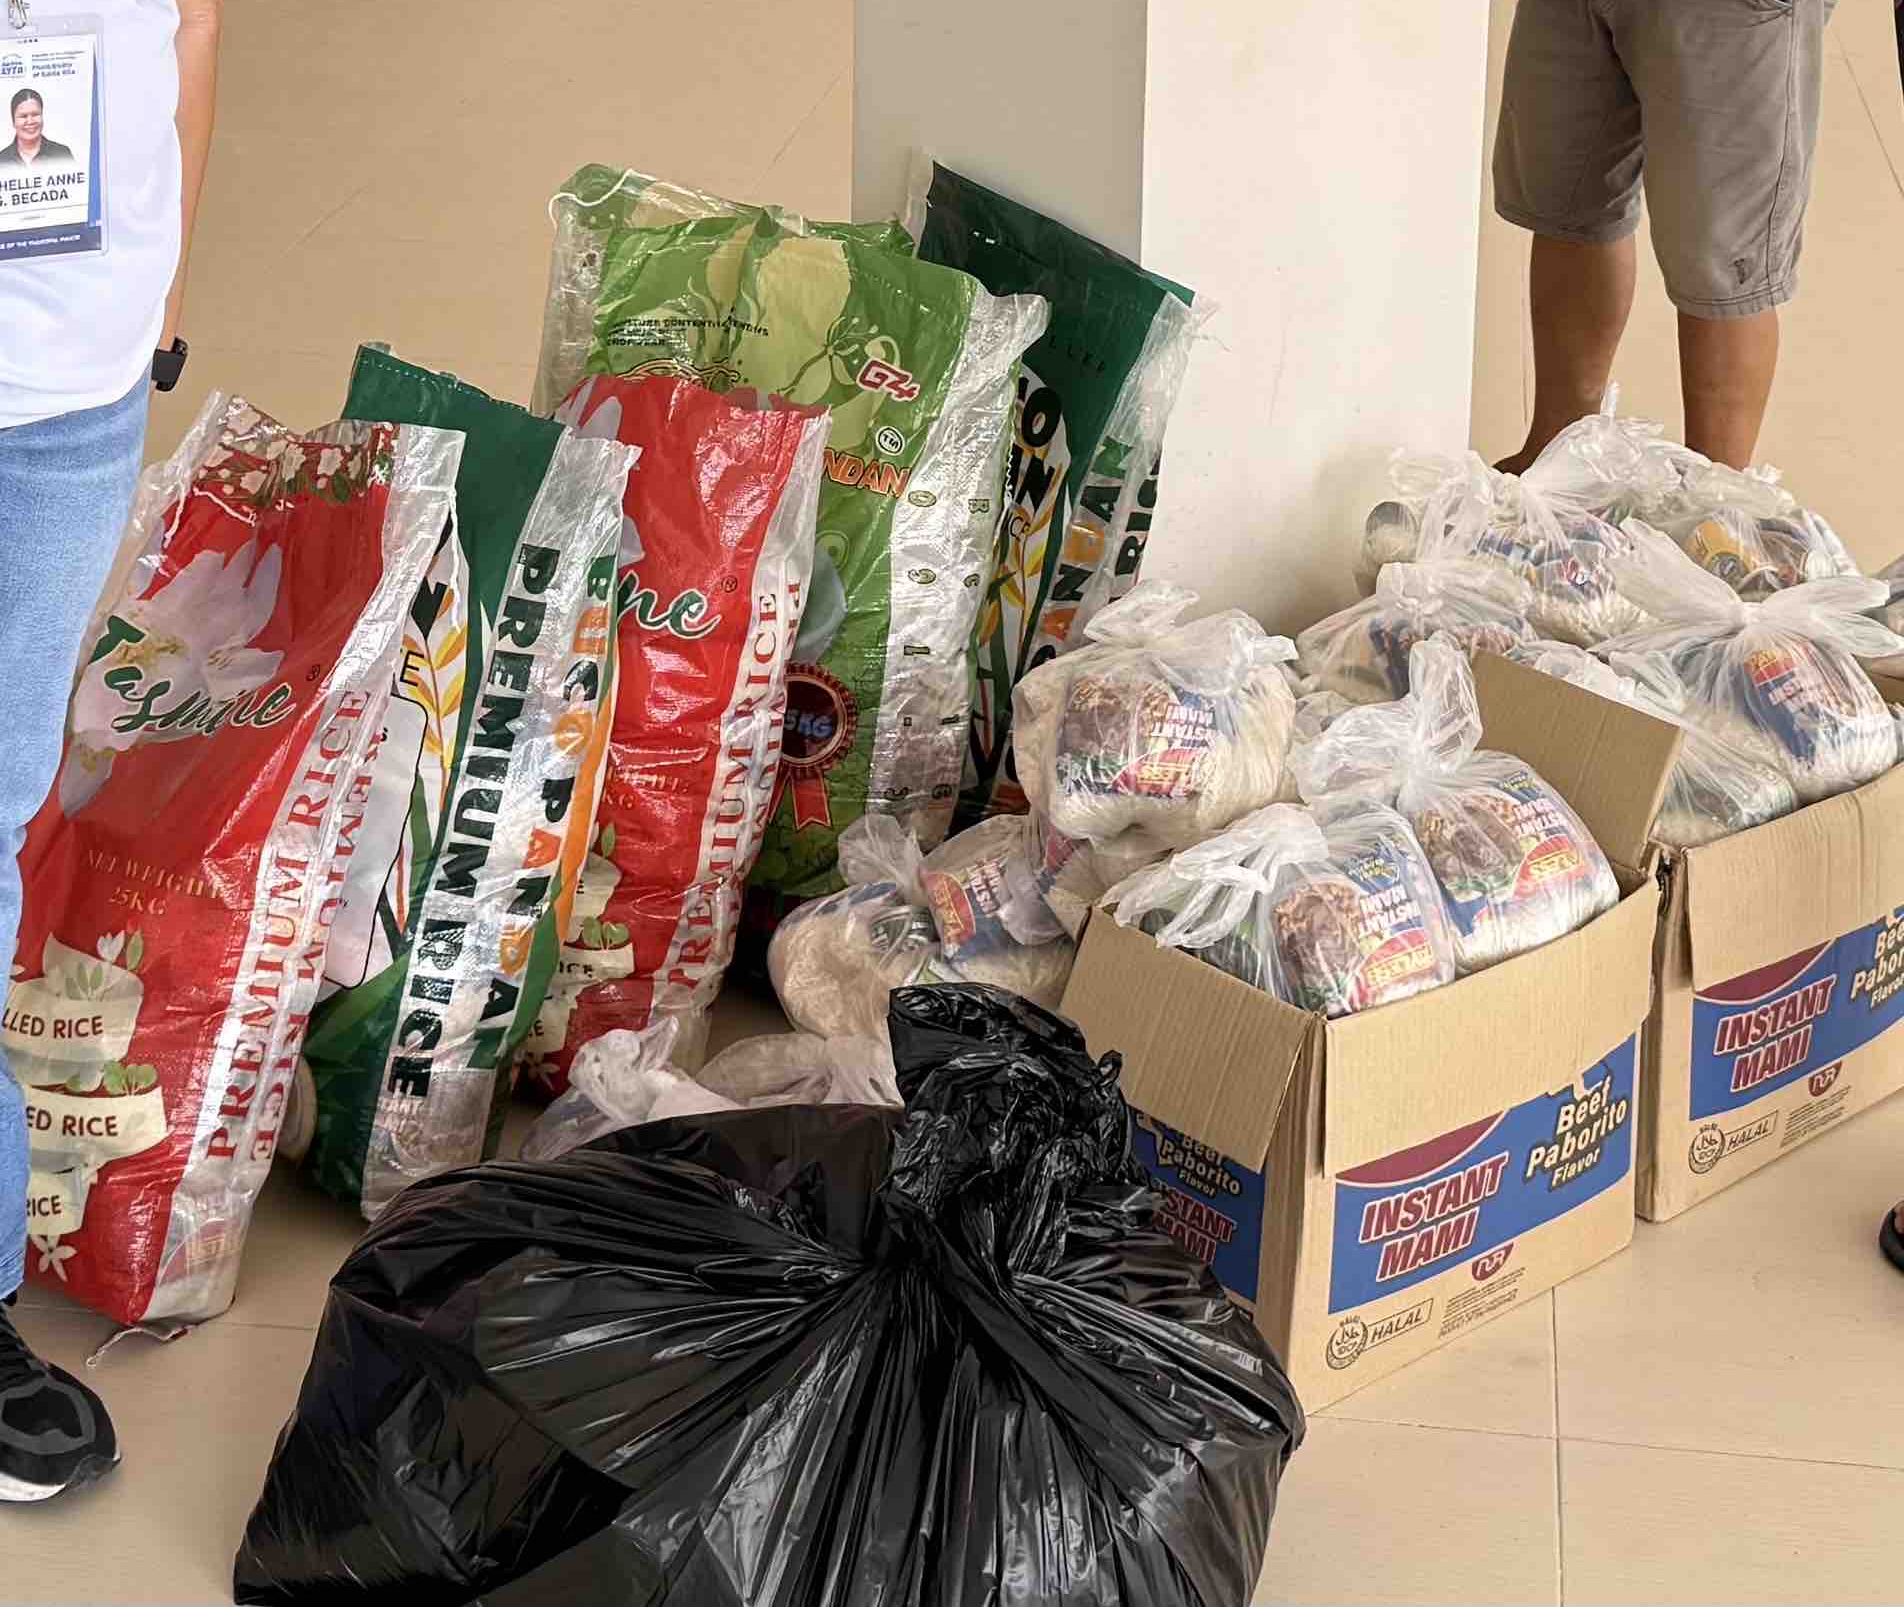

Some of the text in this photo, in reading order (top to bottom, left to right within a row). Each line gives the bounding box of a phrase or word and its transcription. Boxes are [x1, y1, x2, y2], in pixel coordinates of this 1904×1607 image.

[11, 188, 69, 206] BECADA
[46, 171, 86, 187] ANNE
[823, 447, 913, 500] NDAN
[552, 554, 618, 756] BUCO
[435, 542, 562, 899] PREMIUM
[667, 746, 754, 989] PREMIUM
[734, 593, 778, 718] RICE
[207, 857, 310, 1160] PREMIUM
[286, 692, 371, 827] RICE
[467, 776, 576, 1070] PANDAN
[52, 1014, 104, 1039] RICE
[388, 918, 464, 1098] RICE
[1713, 974, 1837, 1057] INSTANT
[1730, 1024, 1813, 1094] MAMI
[61, 1114, 118, 1138] RICE
[1525, 1098, 1629, 1179] Paborito
[1554, 1076, 1614, 1135] Beef
[1727, 1119, 1769, 1152] HALAL
[1161, 1138, 1242, 1196] Paborito
[1358, 1152, 1510, 1244] INSTANT
[1549, 1145, 1602, 1193] Flavor
[1376, 1206, 1481, 1283] MAMI
[1371, 1307, 1423, 1344] HALAL
